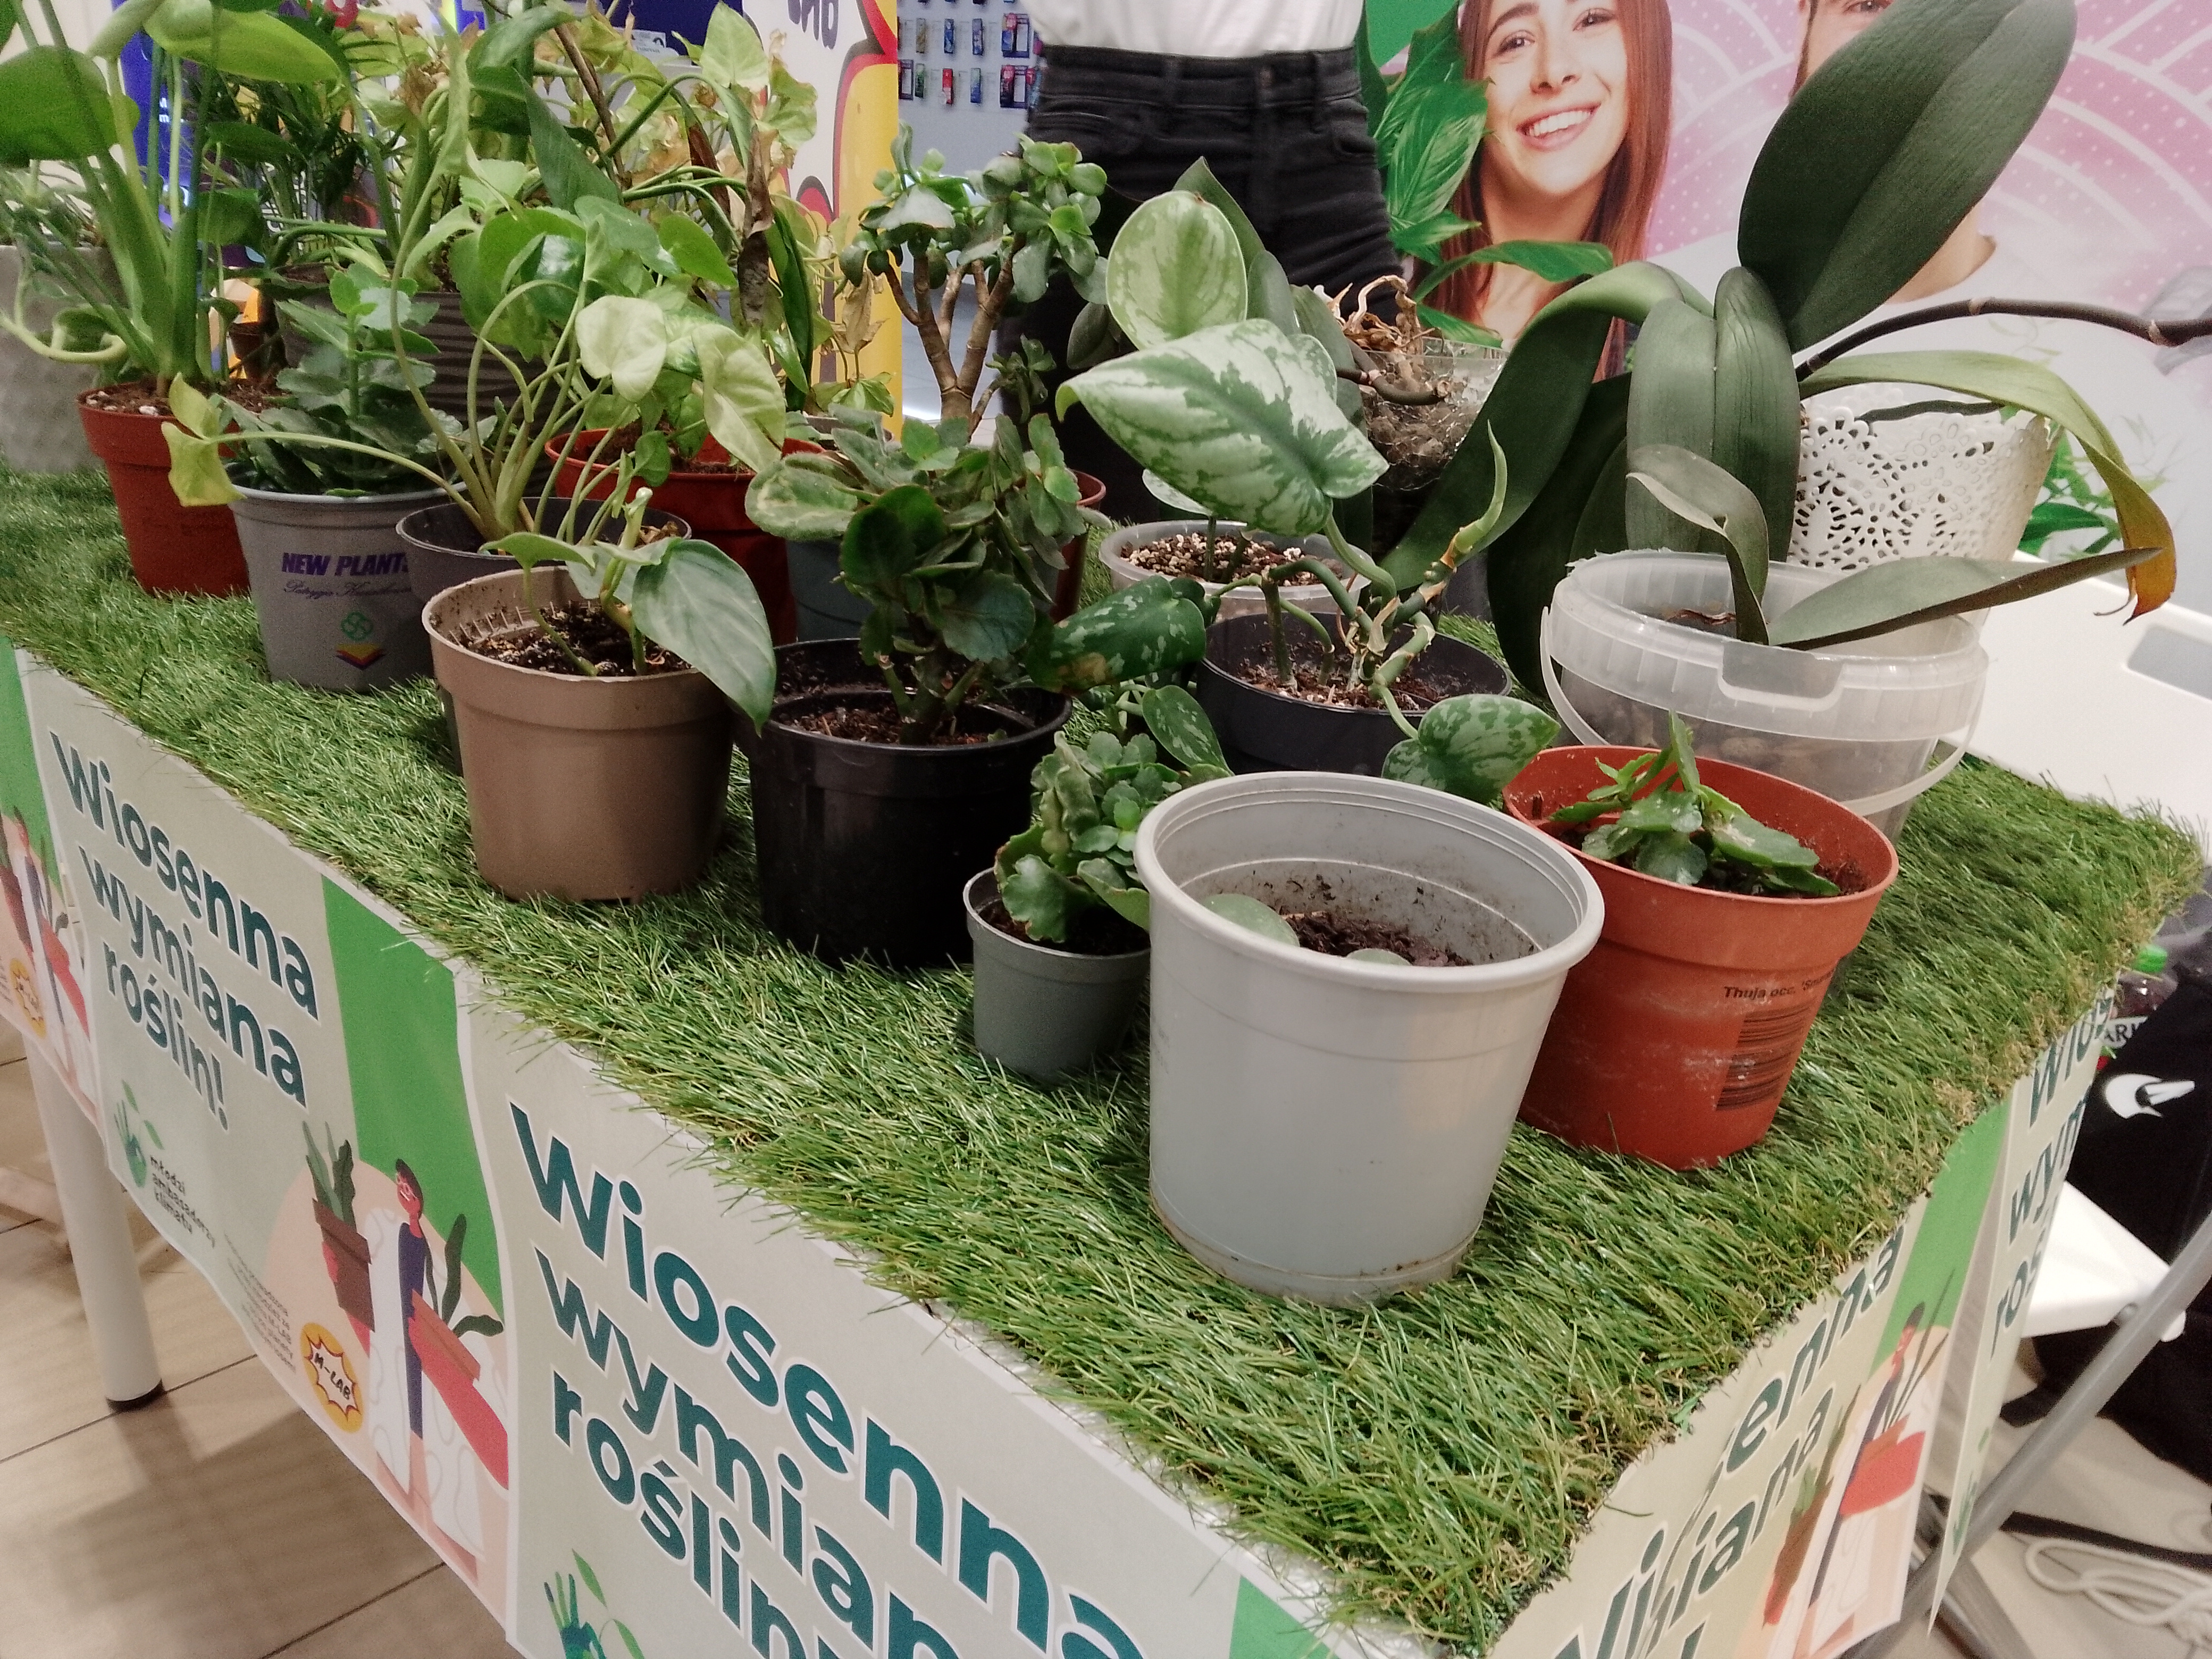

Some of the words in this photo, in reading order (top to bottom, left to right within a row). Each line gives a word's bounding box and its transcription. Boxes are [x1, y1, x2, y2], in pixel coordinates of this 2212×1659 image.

[282, 552, 331, 576] NEW
[50, 731, 319, 1021] Wiosenna
[79, 845, 306, 1109] wymiana
[103, 942, 229, 1132] roślin!
[1724, 986, 1766, 1000] Thuja
[314, 1352, 351, 1400] M-LAB
[554, 1370, 841, 1659] roślin
